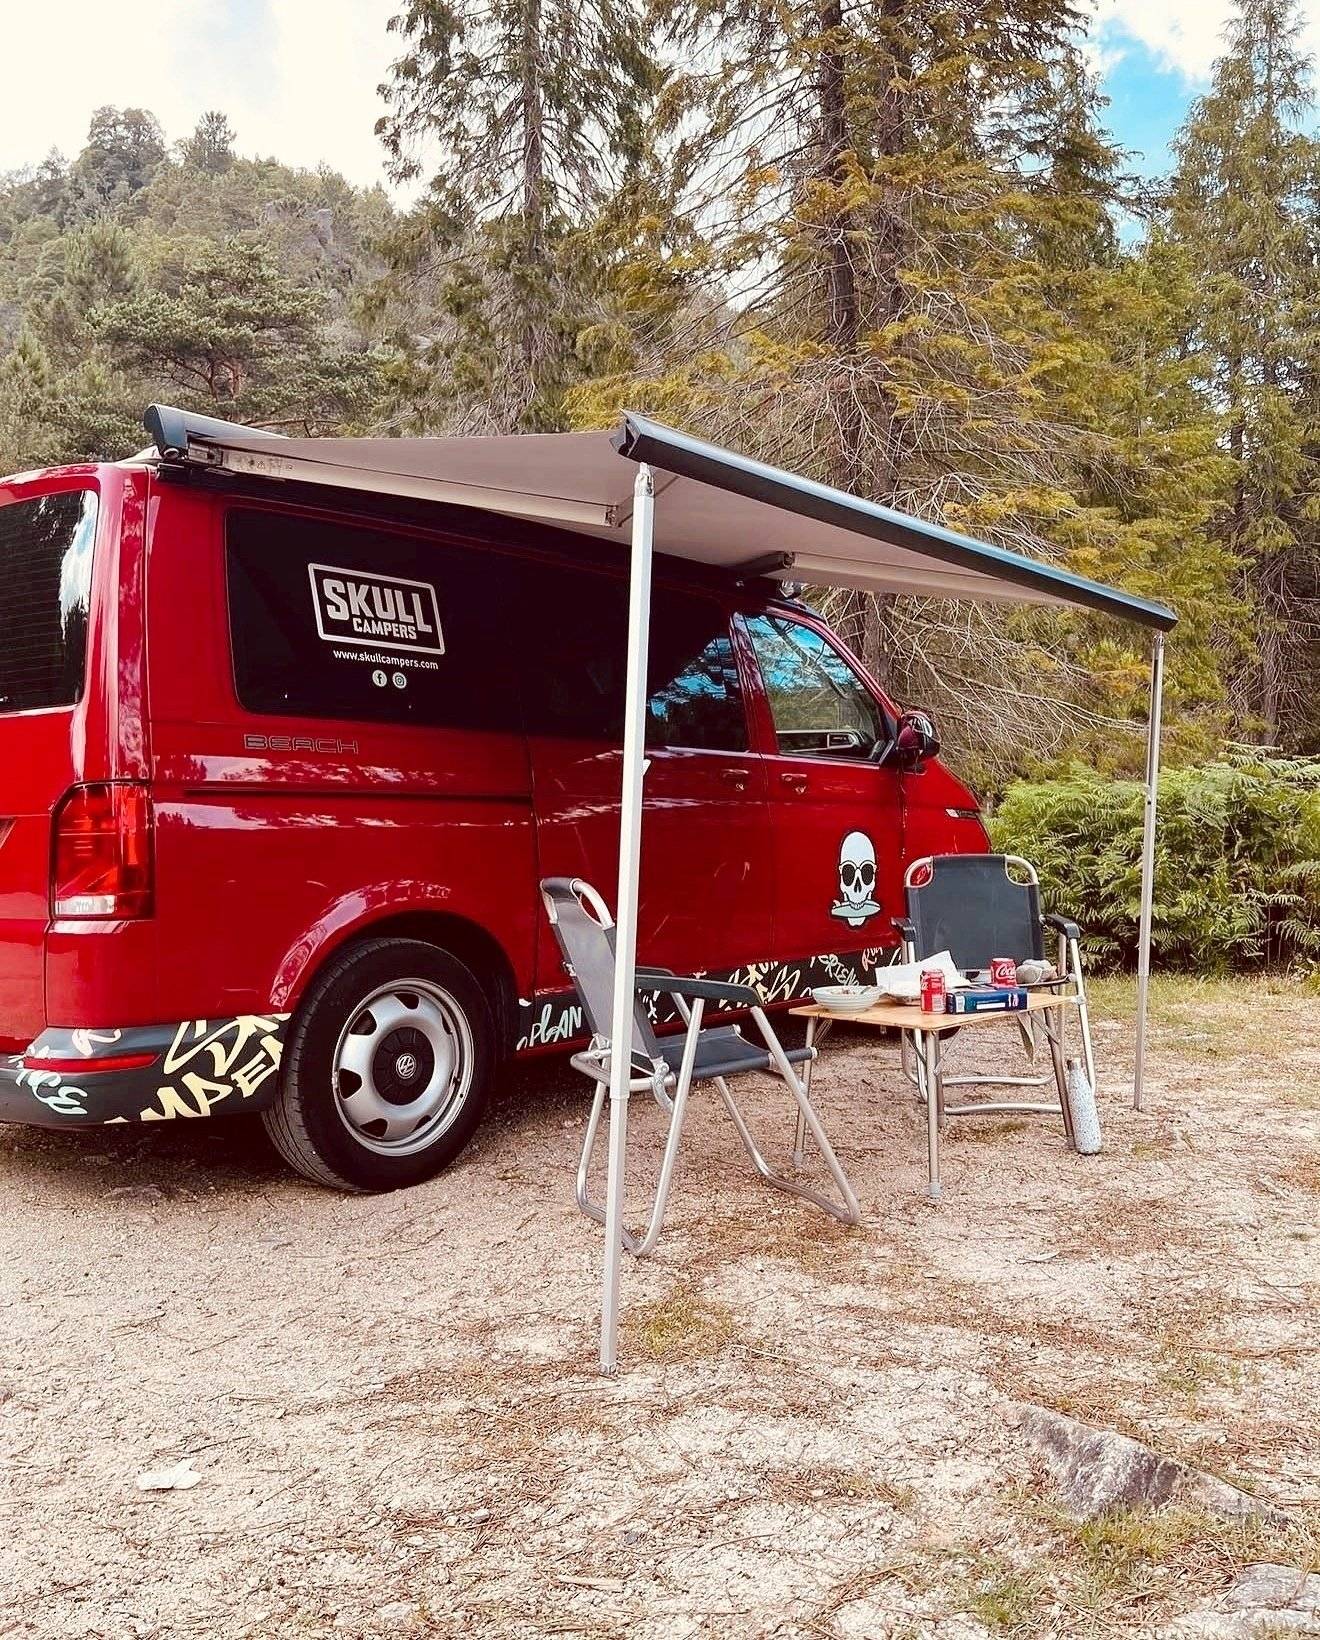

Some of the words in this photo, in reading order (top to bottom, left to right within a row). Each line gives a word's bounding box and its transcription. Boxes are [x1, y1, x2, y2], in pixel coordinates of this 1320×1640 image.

[323, 578, 433, 633] SKULL
[352, 617, 417, 640] CAMPERS
[333, 649, 439, 670] www.skullcampers.com
[243, 734, 359, 755] BEACH
